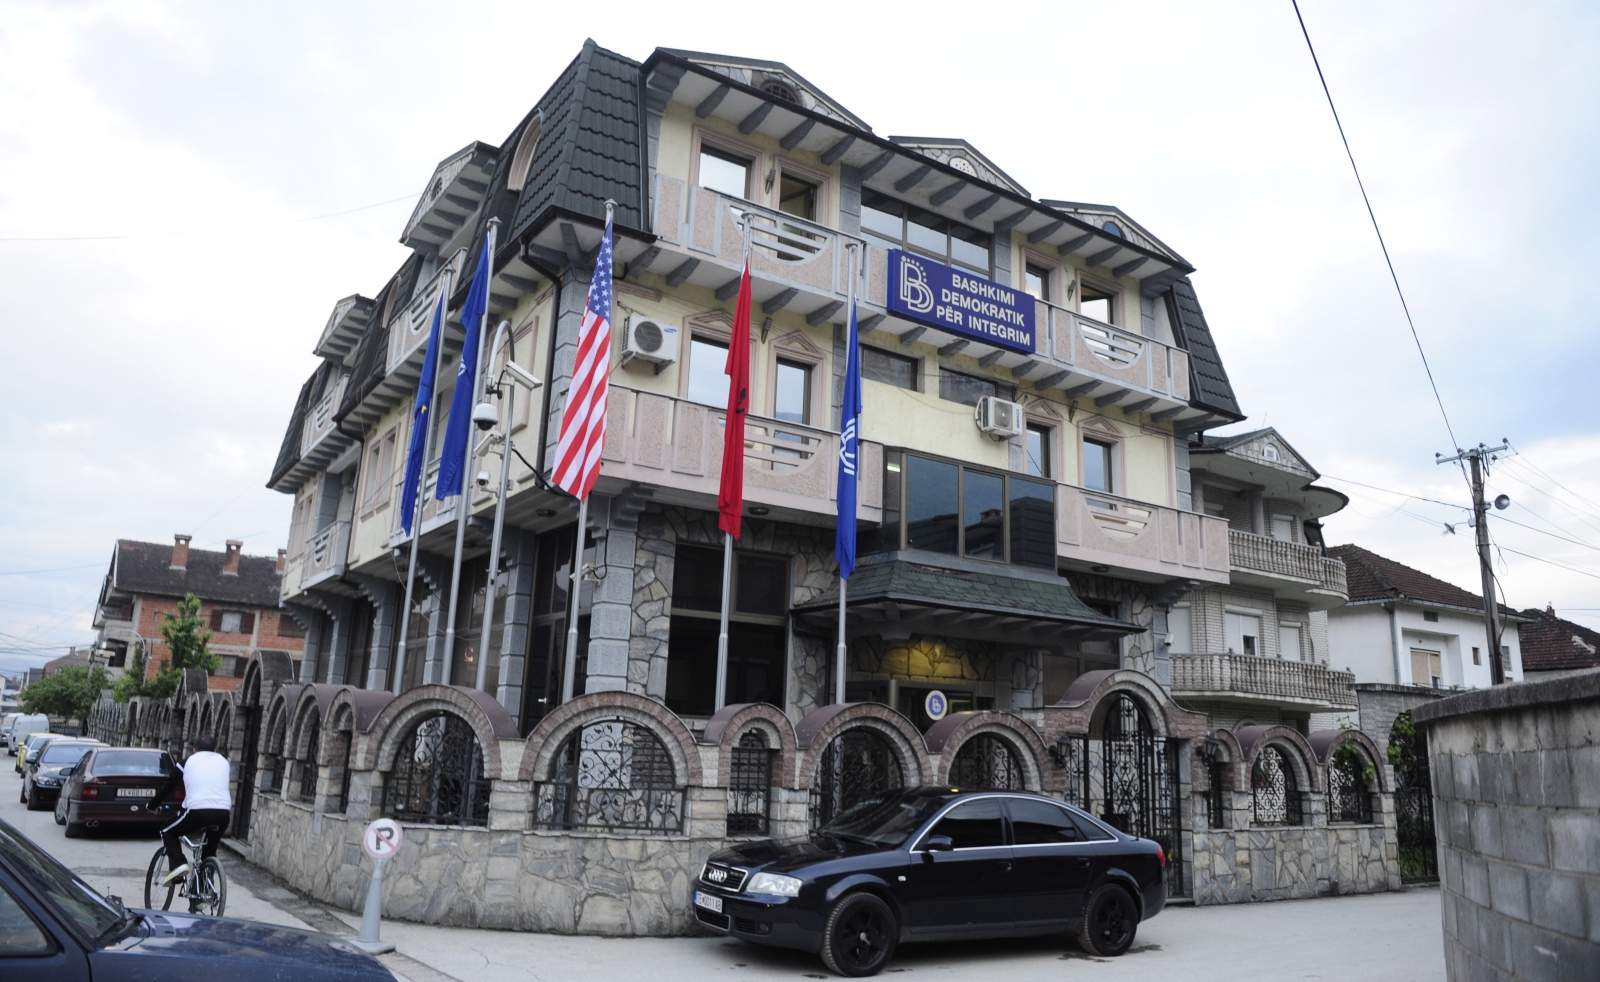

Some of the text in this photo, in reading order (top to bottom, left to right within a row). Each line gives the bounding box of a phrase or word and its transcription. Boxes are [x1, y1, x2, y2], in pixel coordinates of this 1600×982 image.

[941, 288, 1025, 327] DEMOKRATIK
[952, 273, 1015, 307] BASHKIMI
[936, 305, 1030, 346] PËR INTEGRIM
[376, 827, 394, 850] P
